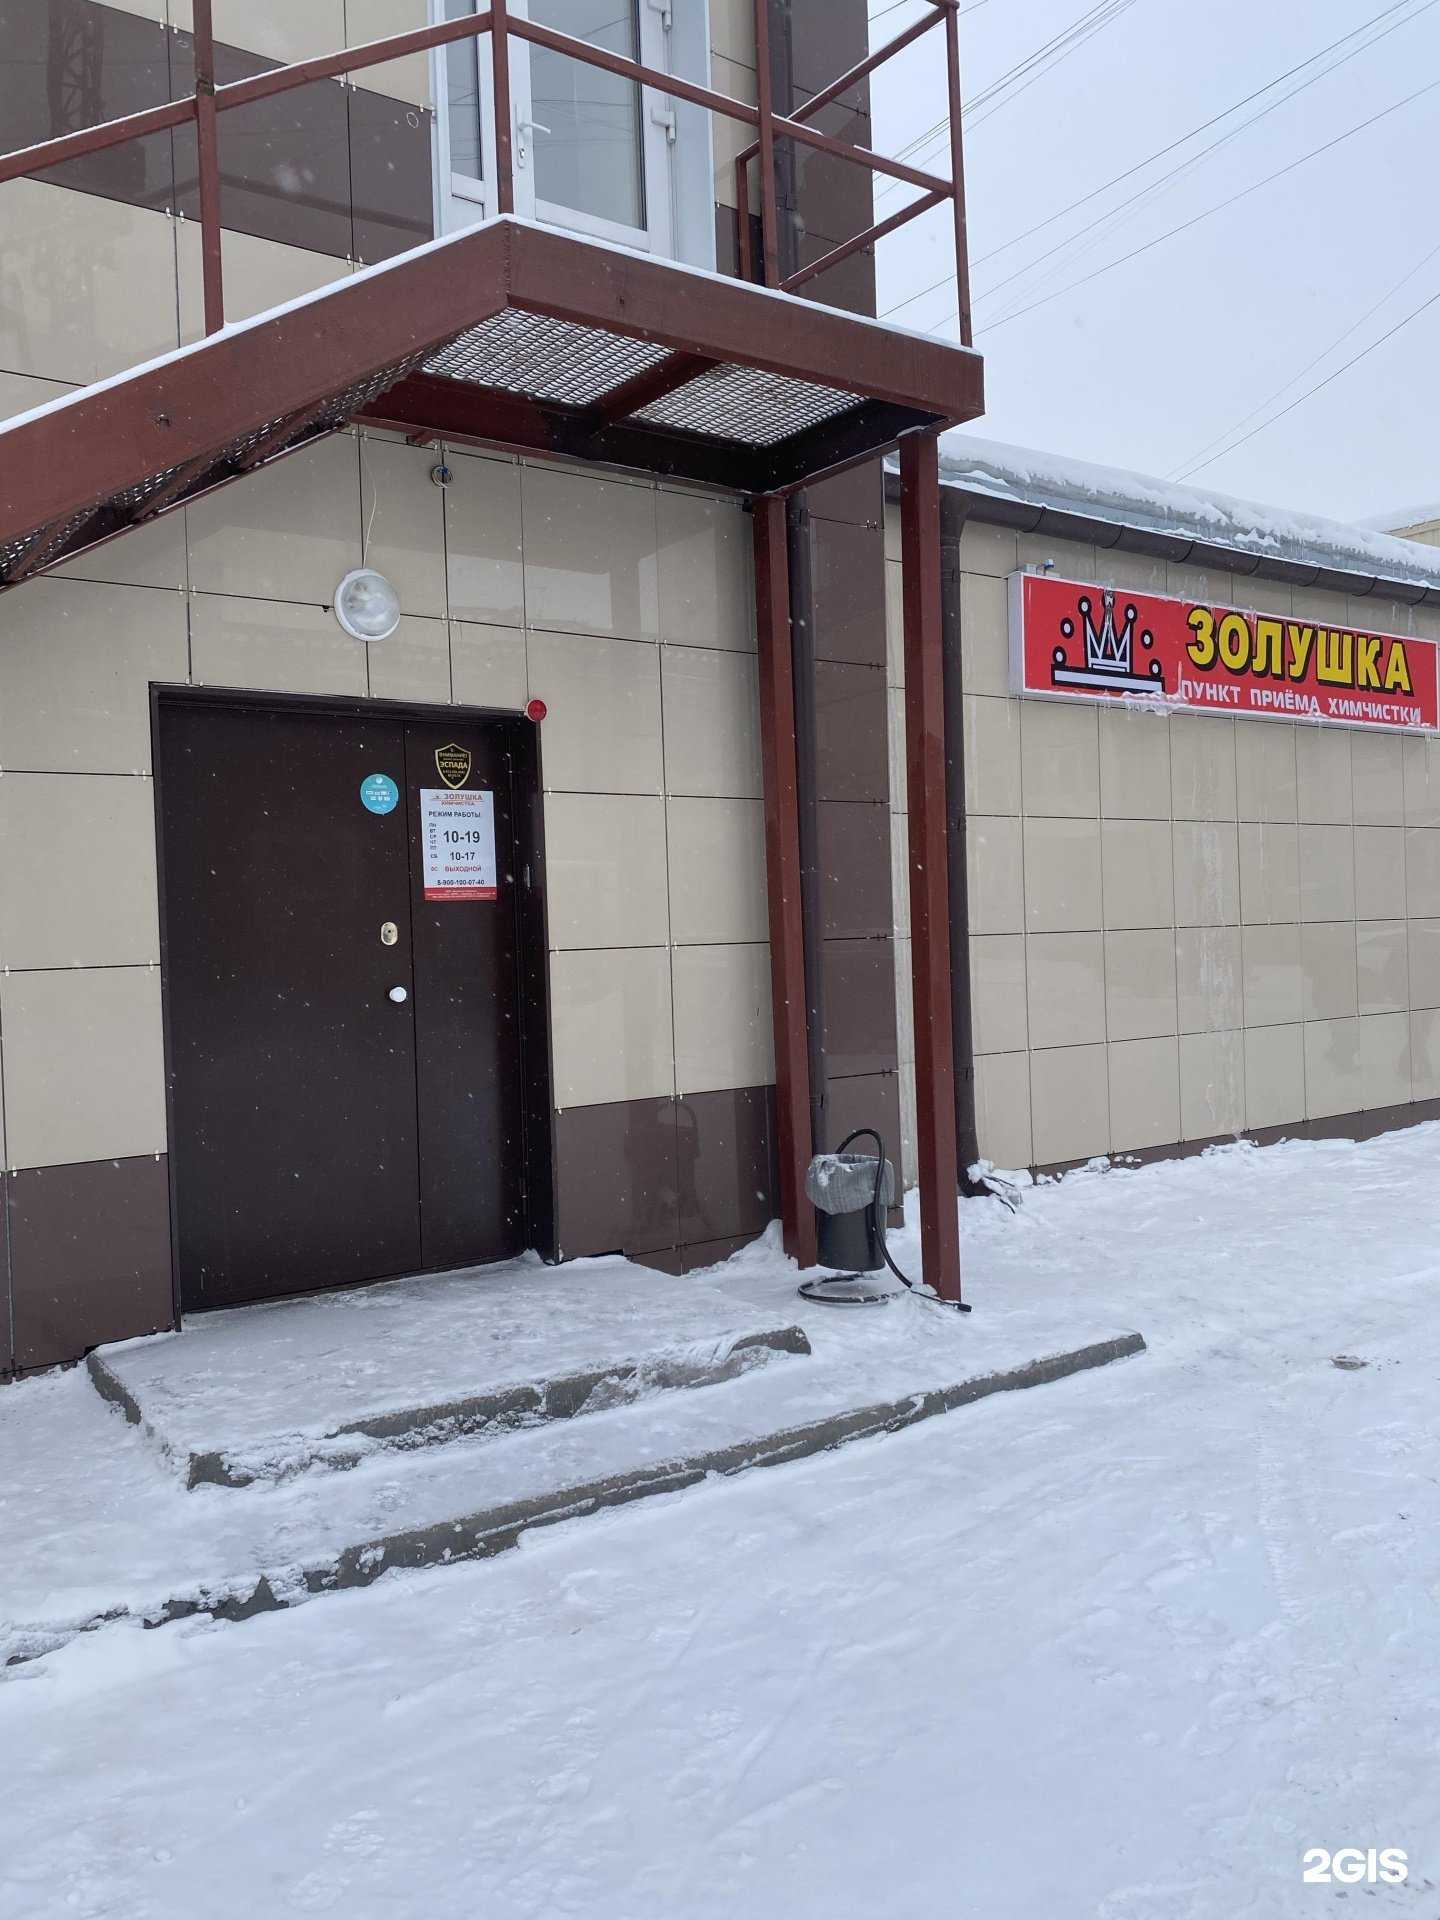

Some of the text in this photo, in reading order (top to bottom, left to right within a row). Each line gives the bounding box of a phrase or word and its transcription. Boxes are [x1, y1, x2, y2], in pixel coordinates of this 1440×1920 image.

[1186, 605, 1414, 696] ЗОЛУШКА
[1181, 680, 1422, 724] ПУНКТ ПРИЁМА ХИМЧИСТКИ
[440, 761, 468, 769] ЭСПАДА
[444, 793, 483, 801] ЗОЛУШКА
[428, 810, 481, 818] РЕЖИМ РАБОТЫ
[443, 830, 481, 844] 10-19
[449, 851, 476, 861] 10-17
